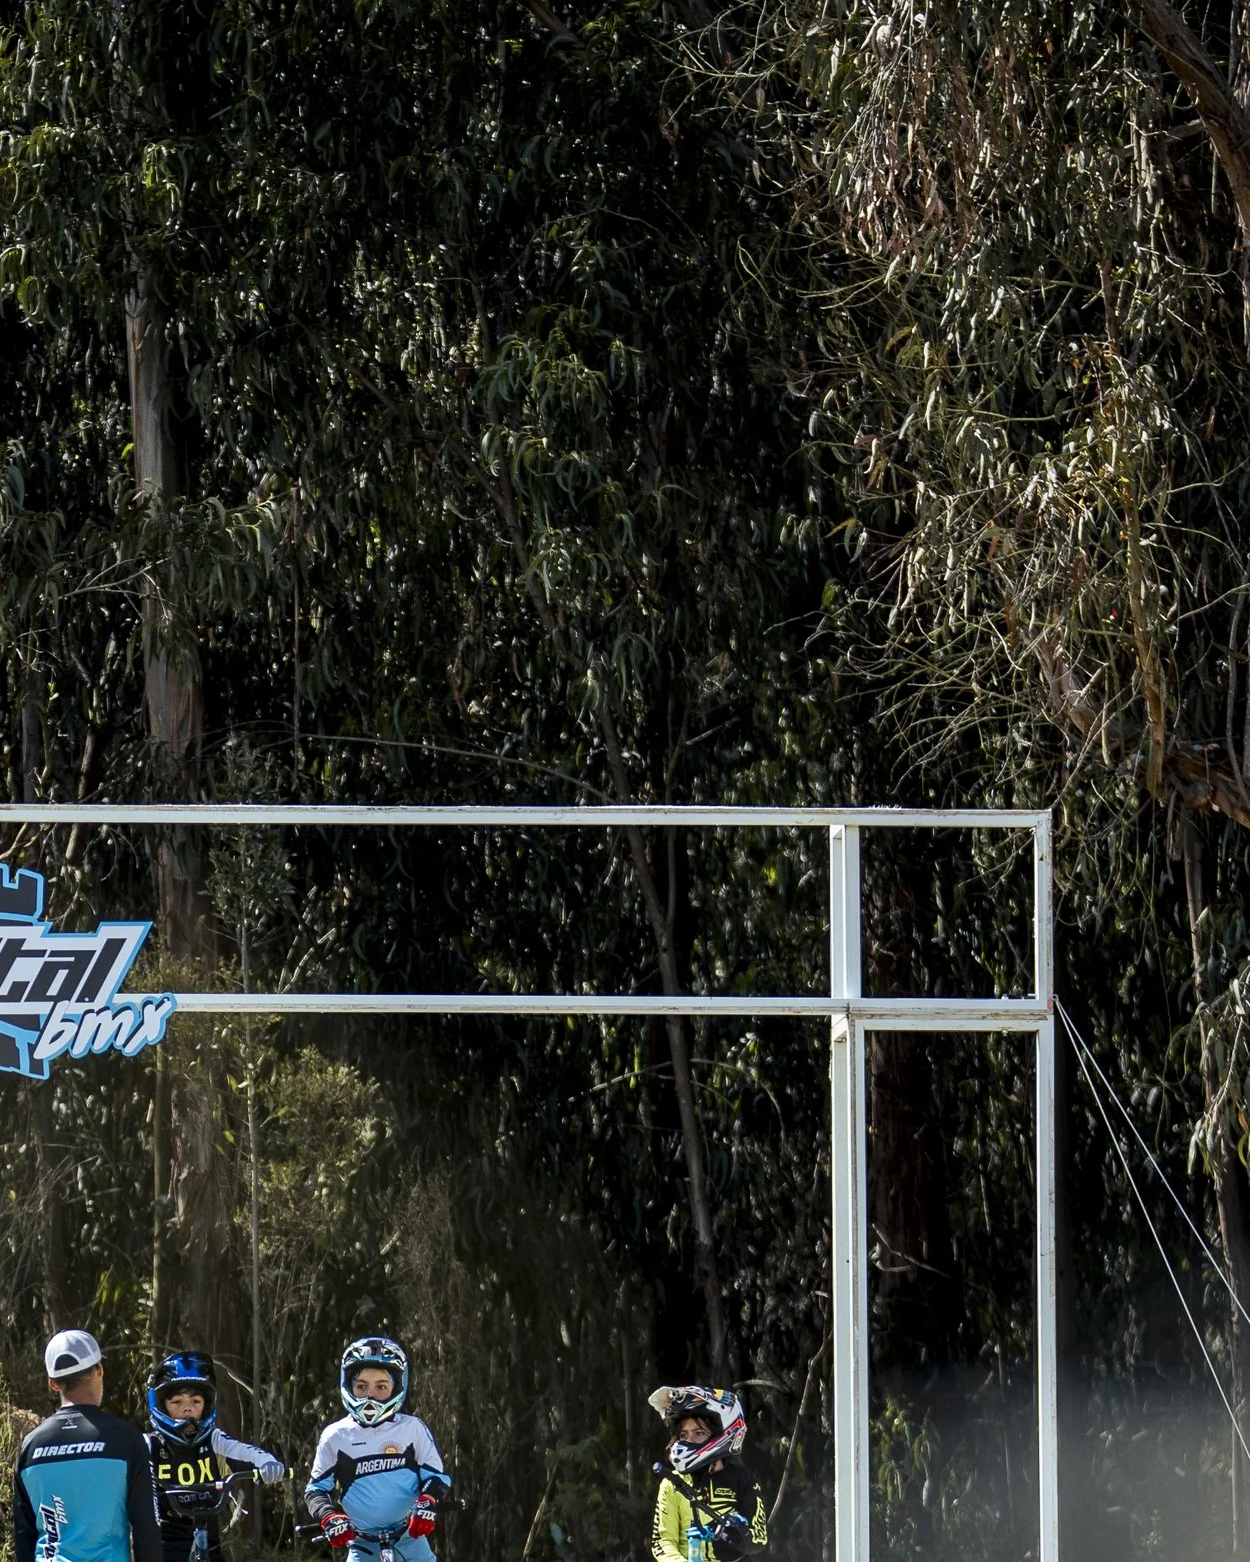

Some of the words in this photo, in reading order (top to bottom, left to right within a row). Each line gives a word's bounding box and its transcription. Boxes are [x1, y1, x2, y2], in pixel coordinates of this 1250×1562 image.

[33, 996, 173, 1060] bmx
[32, 1441, 106, 1460] DIRECTOR
[158, 1457, 214, 1486] FOX
[355, 1457, 406, 1475] ARGENTINA
[329, 1523, 348, 1536] FOX
